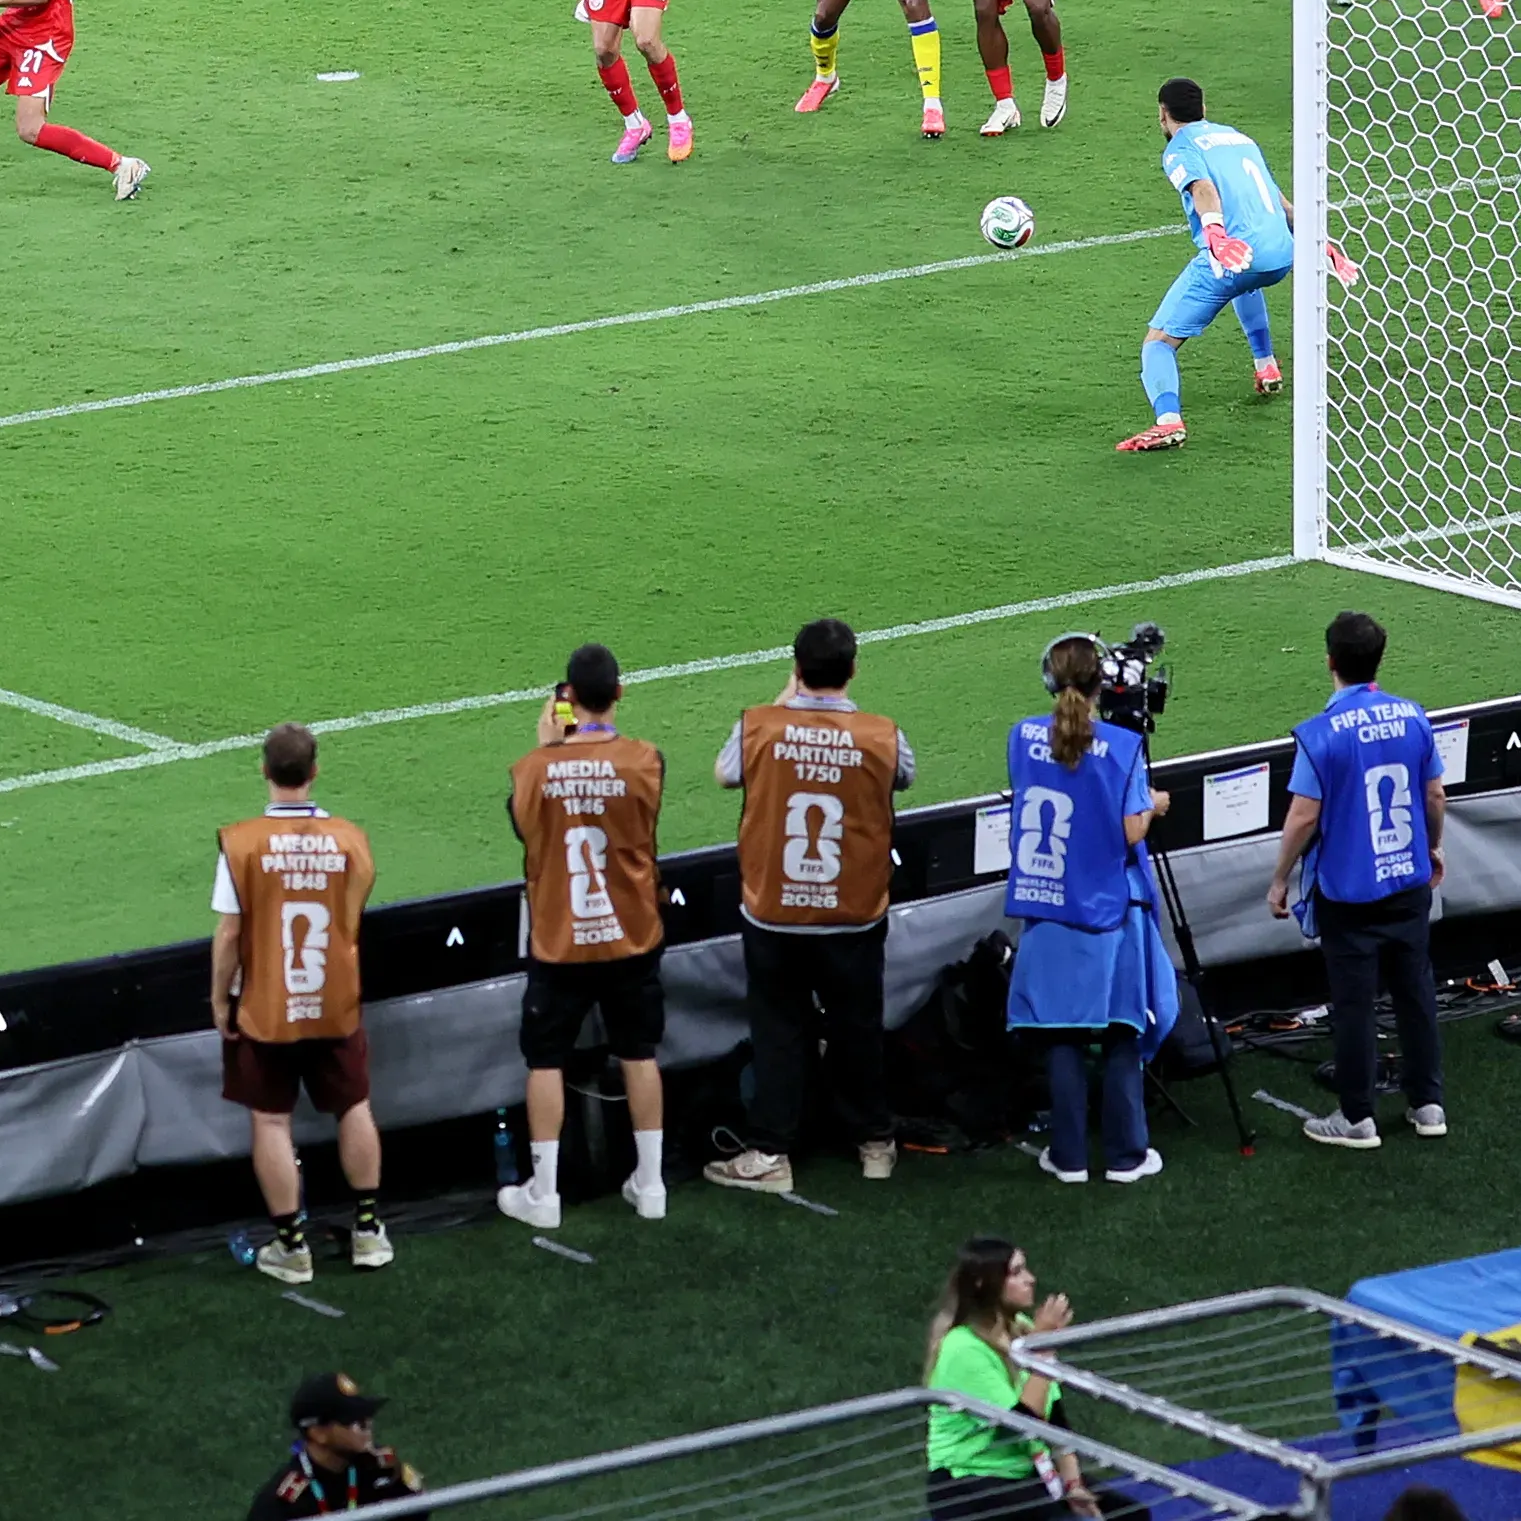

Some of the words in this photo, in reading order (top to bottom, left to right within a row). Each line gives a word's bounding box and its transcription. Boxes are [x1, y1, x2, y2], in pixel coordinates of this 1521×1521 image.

[18, 50, 42, 74] 21
[1242, 157, 1276, 215] 1
[1331, 708, 1372, 733] FIFA
[1371, 702, 1419, 722] TEAM
[786, 725, 854, 748] MEDIA
[1359, 720, 1407, 744] CREW
[774, 742, 864, 767] PARTNER
[548, 761, 617, 779] MEDIA
[795, 765, 842, 784] 1750
[543, 780, 626, 799] PARTNER
[270, 834, 338, 853] MEDIA
[1378, 832, 1399, 846] FIFA
[262, 855, 347, 874] PARTNER
[799, 862, 825, 874] FIFA
[1032, 857, 1056, 871] FIFA
[782, 884, 818, 893] WORLD
[819, 885, 838, 894] CUP
[1015, 877, 1047, 890] WORLD
[1048, 880, 1065, 892] CUP
[782, 894, 839, 909] 2026
[1015, 888, 1066, 907] 2026
[574, 927, 625, 946] 2026
